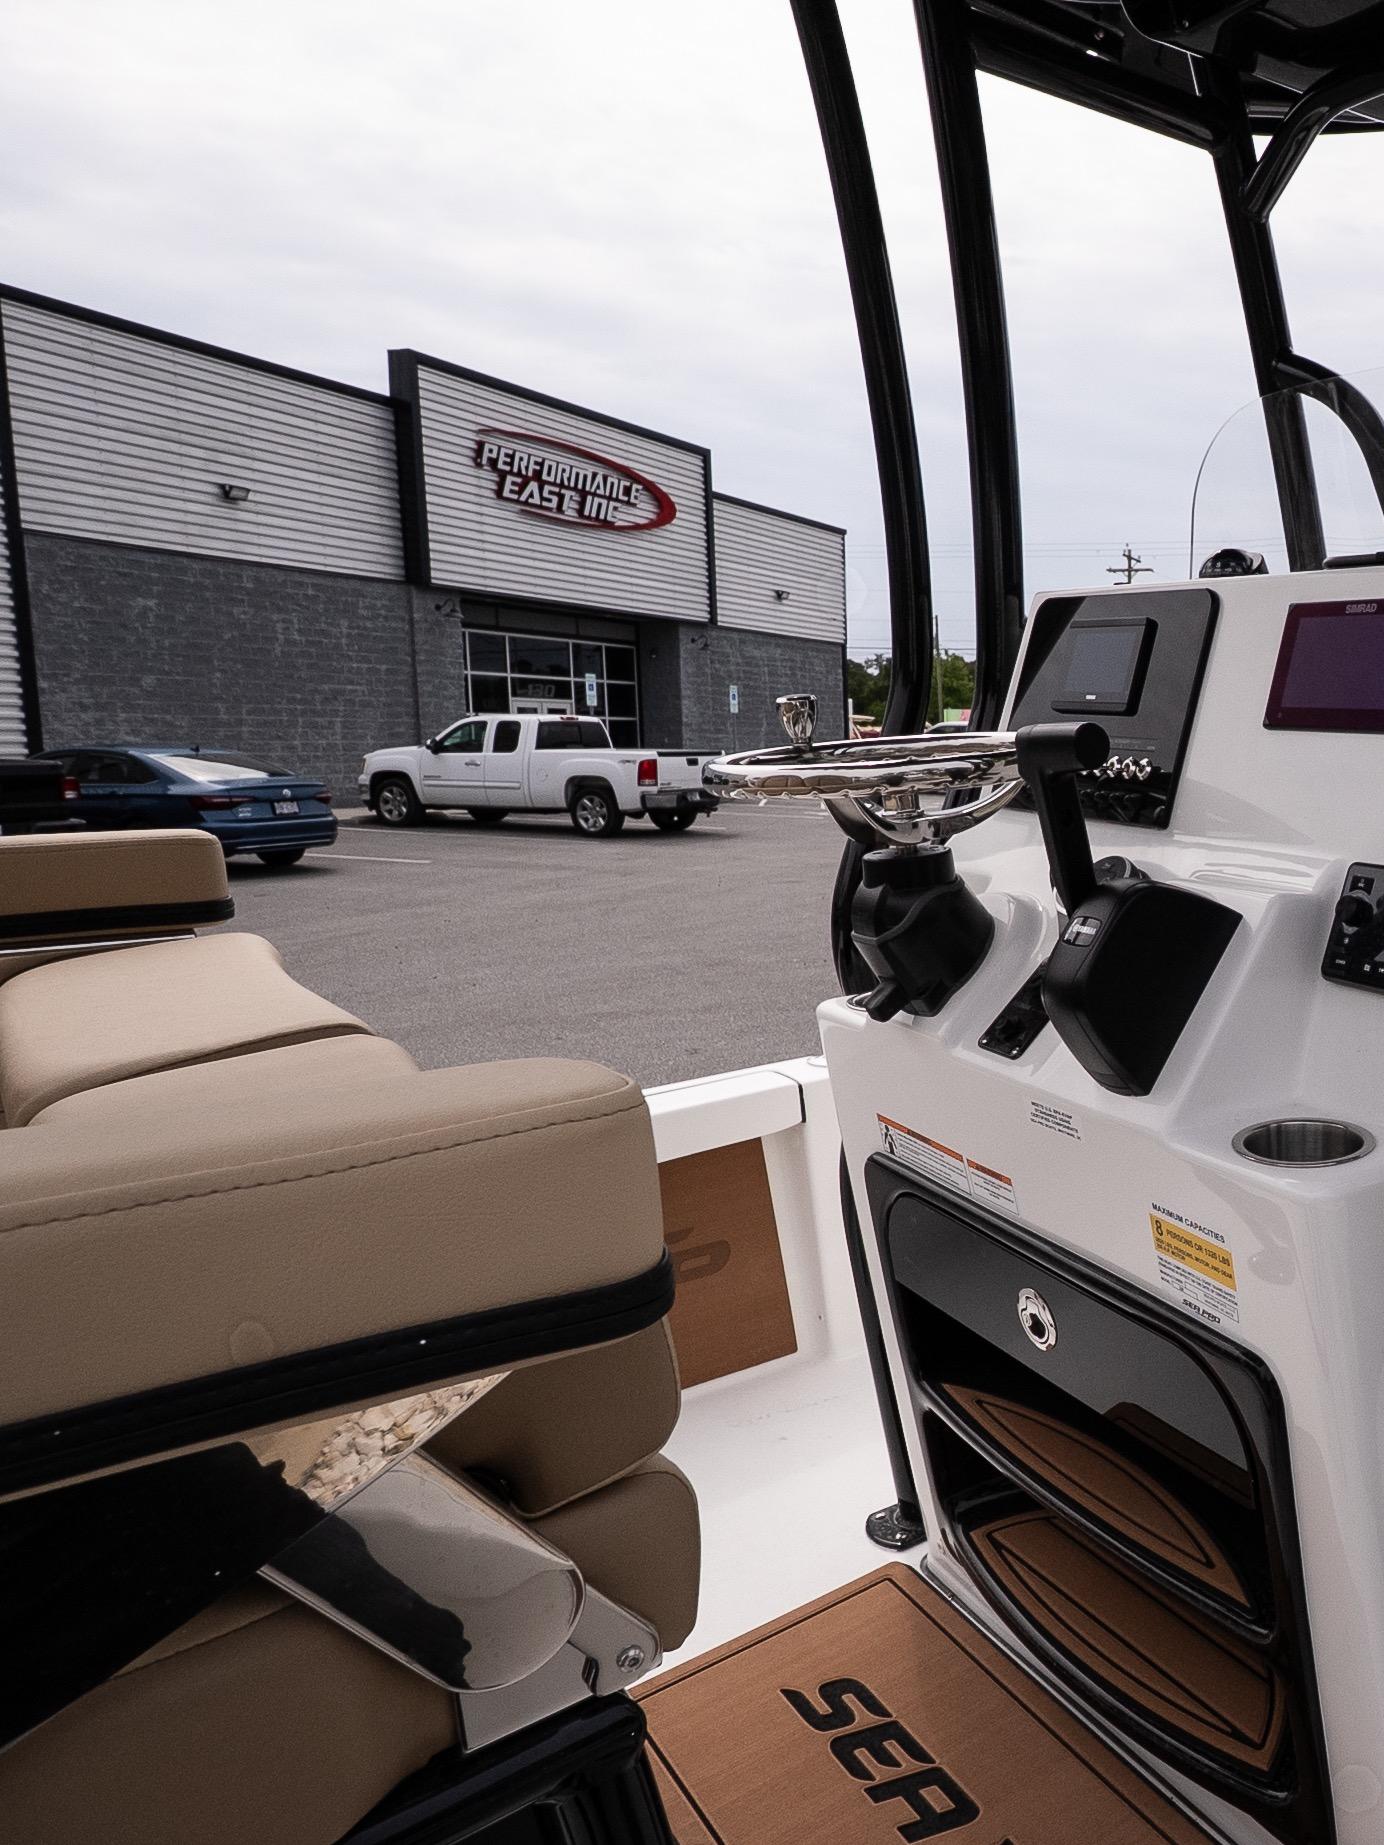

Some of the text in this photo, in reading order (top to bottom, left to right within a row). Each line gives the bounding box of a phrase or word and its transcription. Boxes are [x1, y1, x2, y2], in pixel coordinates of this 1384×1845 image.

[481, 442, 643, 503] PERFORMANCE
[502, 474, 622, 522] EAST INC
[1152, 1202, 1184, 1223] MAXIMUM
[1184, 1218, 1225, 1244] CAPACITIES
[1155, 1220, 1164, 1237] 8
[1166, 1228, 1194, 1248] PERSONS
[1182, 1298, 1201, 1315] SEA
[779, 1676, 982, 1844] SEA
